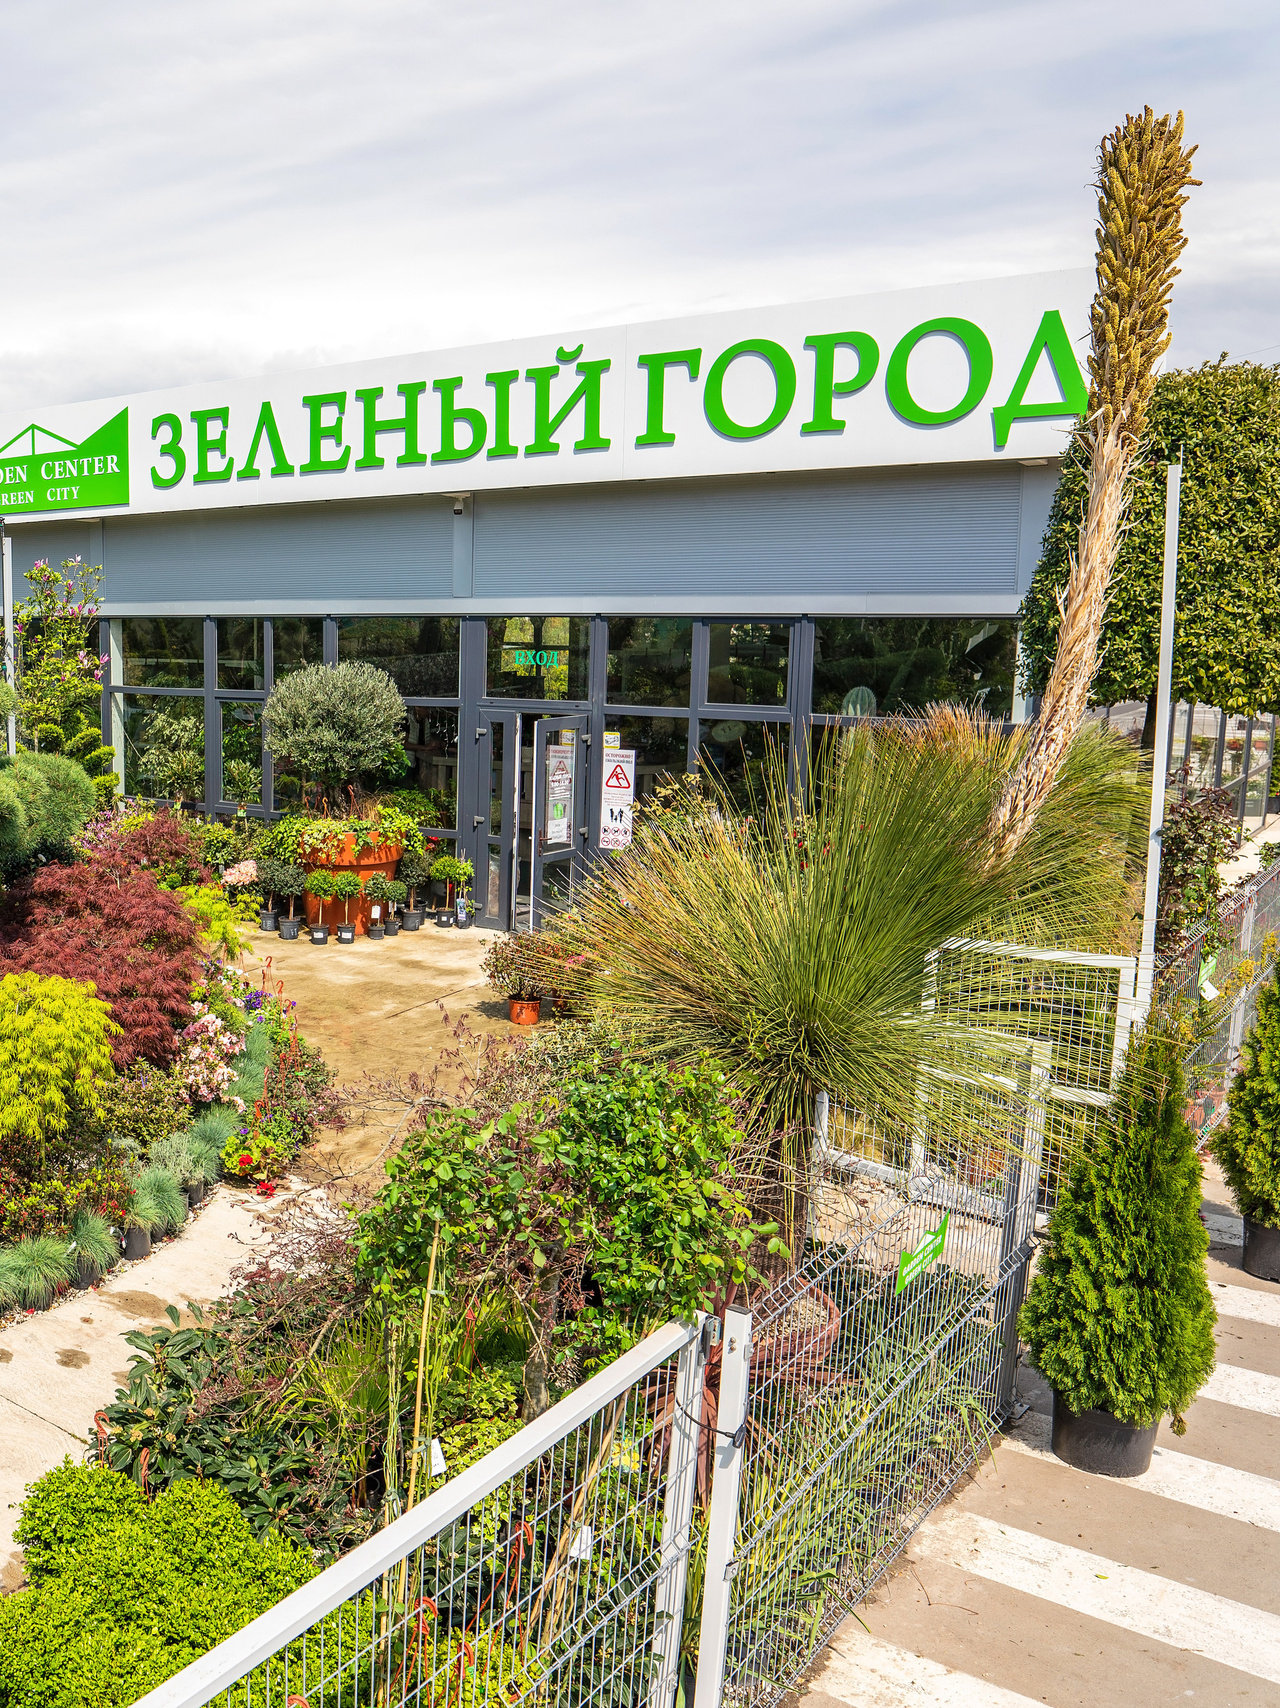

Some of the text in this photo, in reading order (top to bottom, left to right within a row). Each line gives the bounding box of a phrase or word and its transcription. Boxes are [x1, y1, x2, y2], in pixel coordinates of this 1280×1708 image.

[151, 309, 1089, 489] ЗЕЛЕНЫЙ ГОРОД
[40, 454, 120, 480] CENTER
[46, 486, 80, 502] CITY
[515, 650, 559, 669] ВХОД
[902, 1250, 924, 1277] GARDEN
